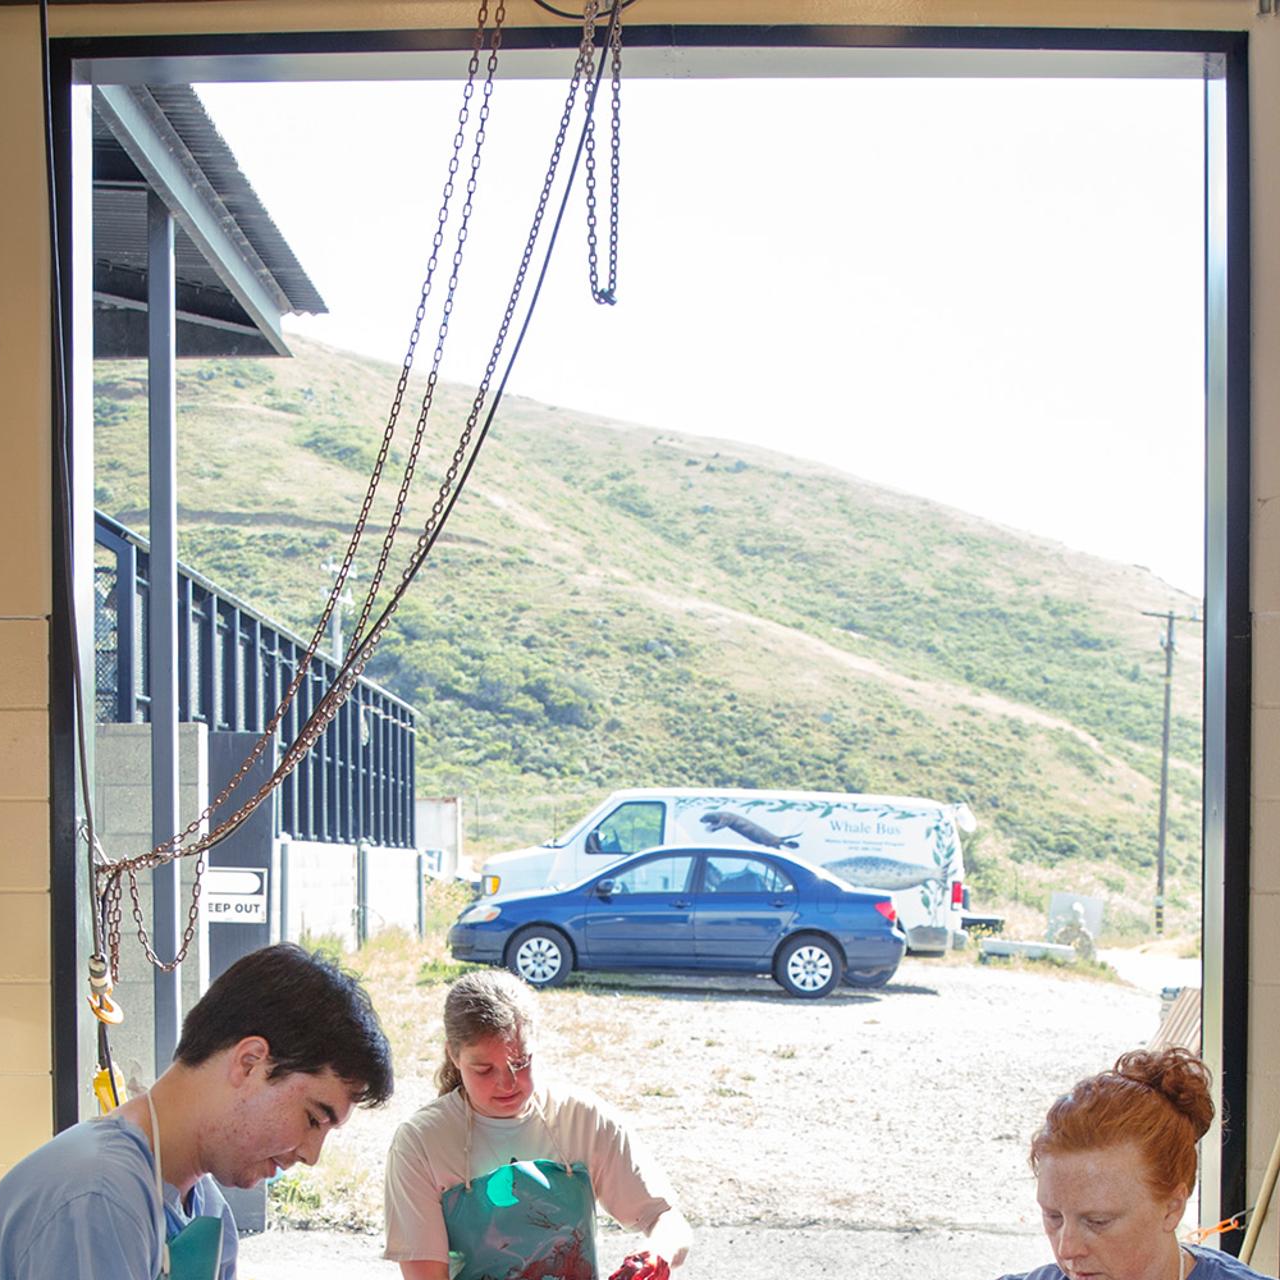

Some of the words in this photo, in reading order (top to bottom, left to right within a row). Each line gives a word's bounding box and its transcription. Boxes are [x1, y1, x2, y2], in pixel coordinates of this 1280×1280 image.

[830, 820, 872, 834] Whale
[876, 822, 902, 835] Bus
[234, 903, 260, 913] OUT
